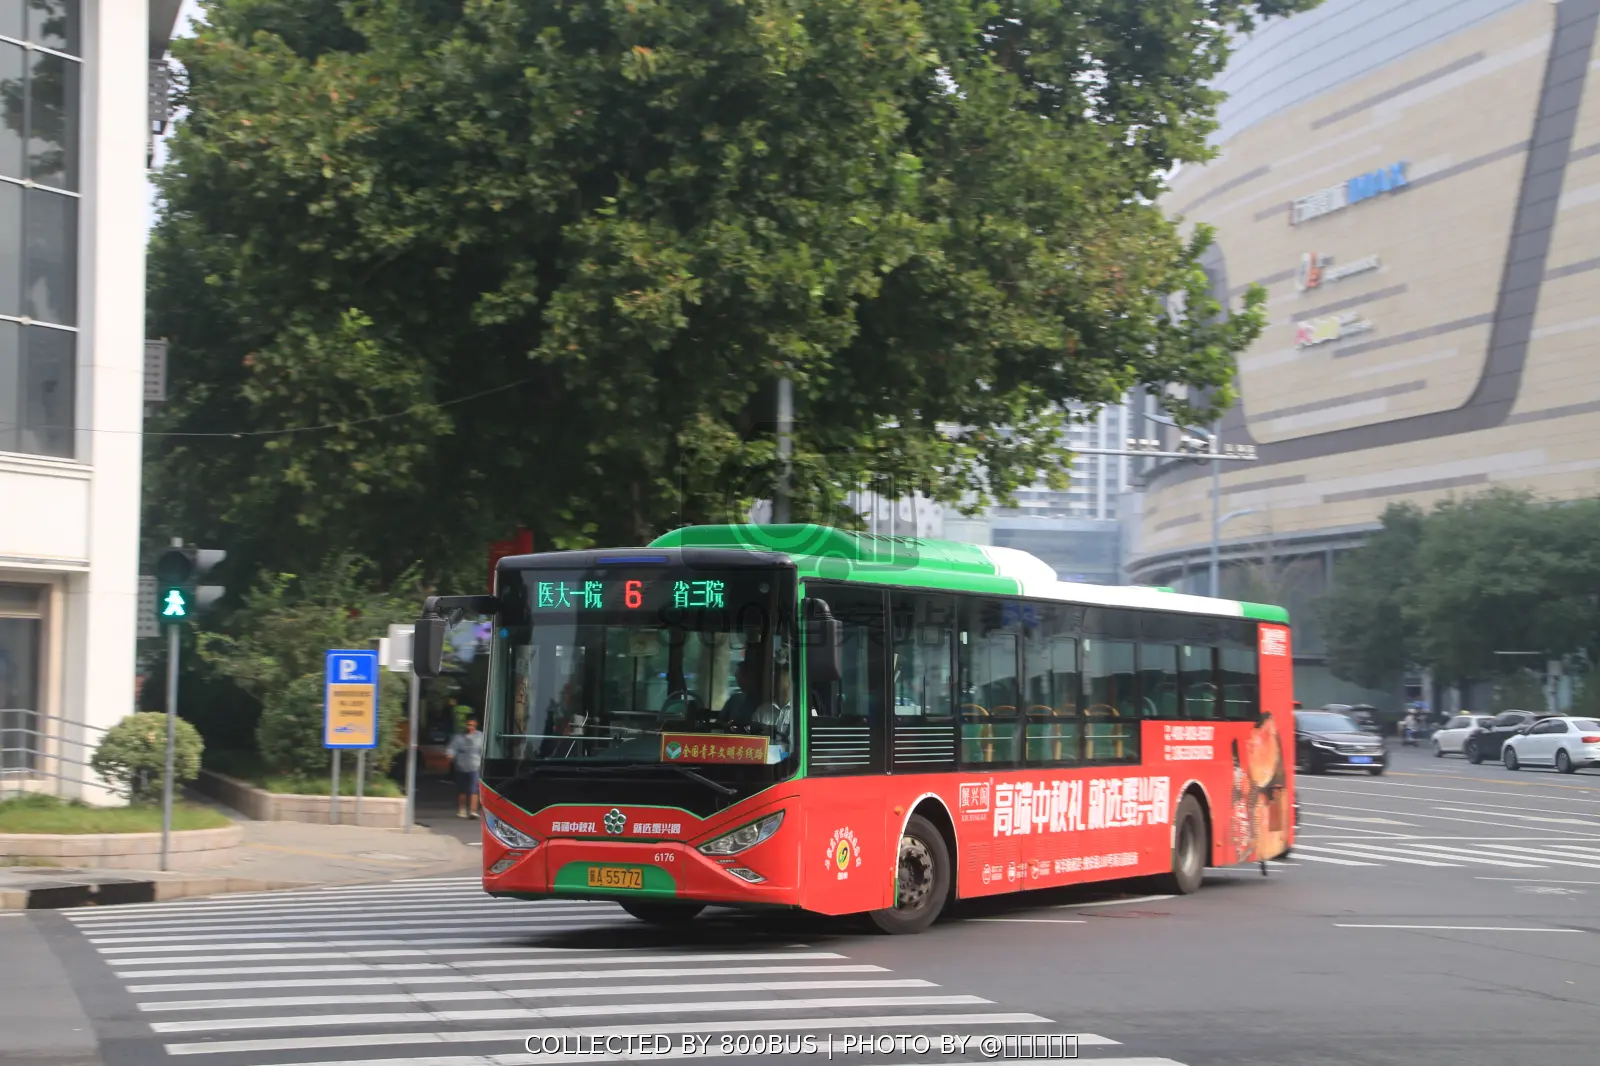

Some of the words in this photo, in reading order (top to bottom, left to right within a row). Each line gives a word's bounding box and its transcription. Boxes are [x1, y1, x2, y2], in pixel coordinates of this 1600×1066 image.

[538, 581, 602, 609] 医大一院
[625, 580, 642, 609] 6
[673, 580, 725, 609] 省三院
[682, 743, 764, 761] 全国青年文明号线路
[994, 779, 1084, 837] 高端中秋礼
[1087, 776, 1170, 830] 就选蟹兴阁
[552, 821, 597, 833] 高端中秋礼
[654, 853, 675, 862] 6176
